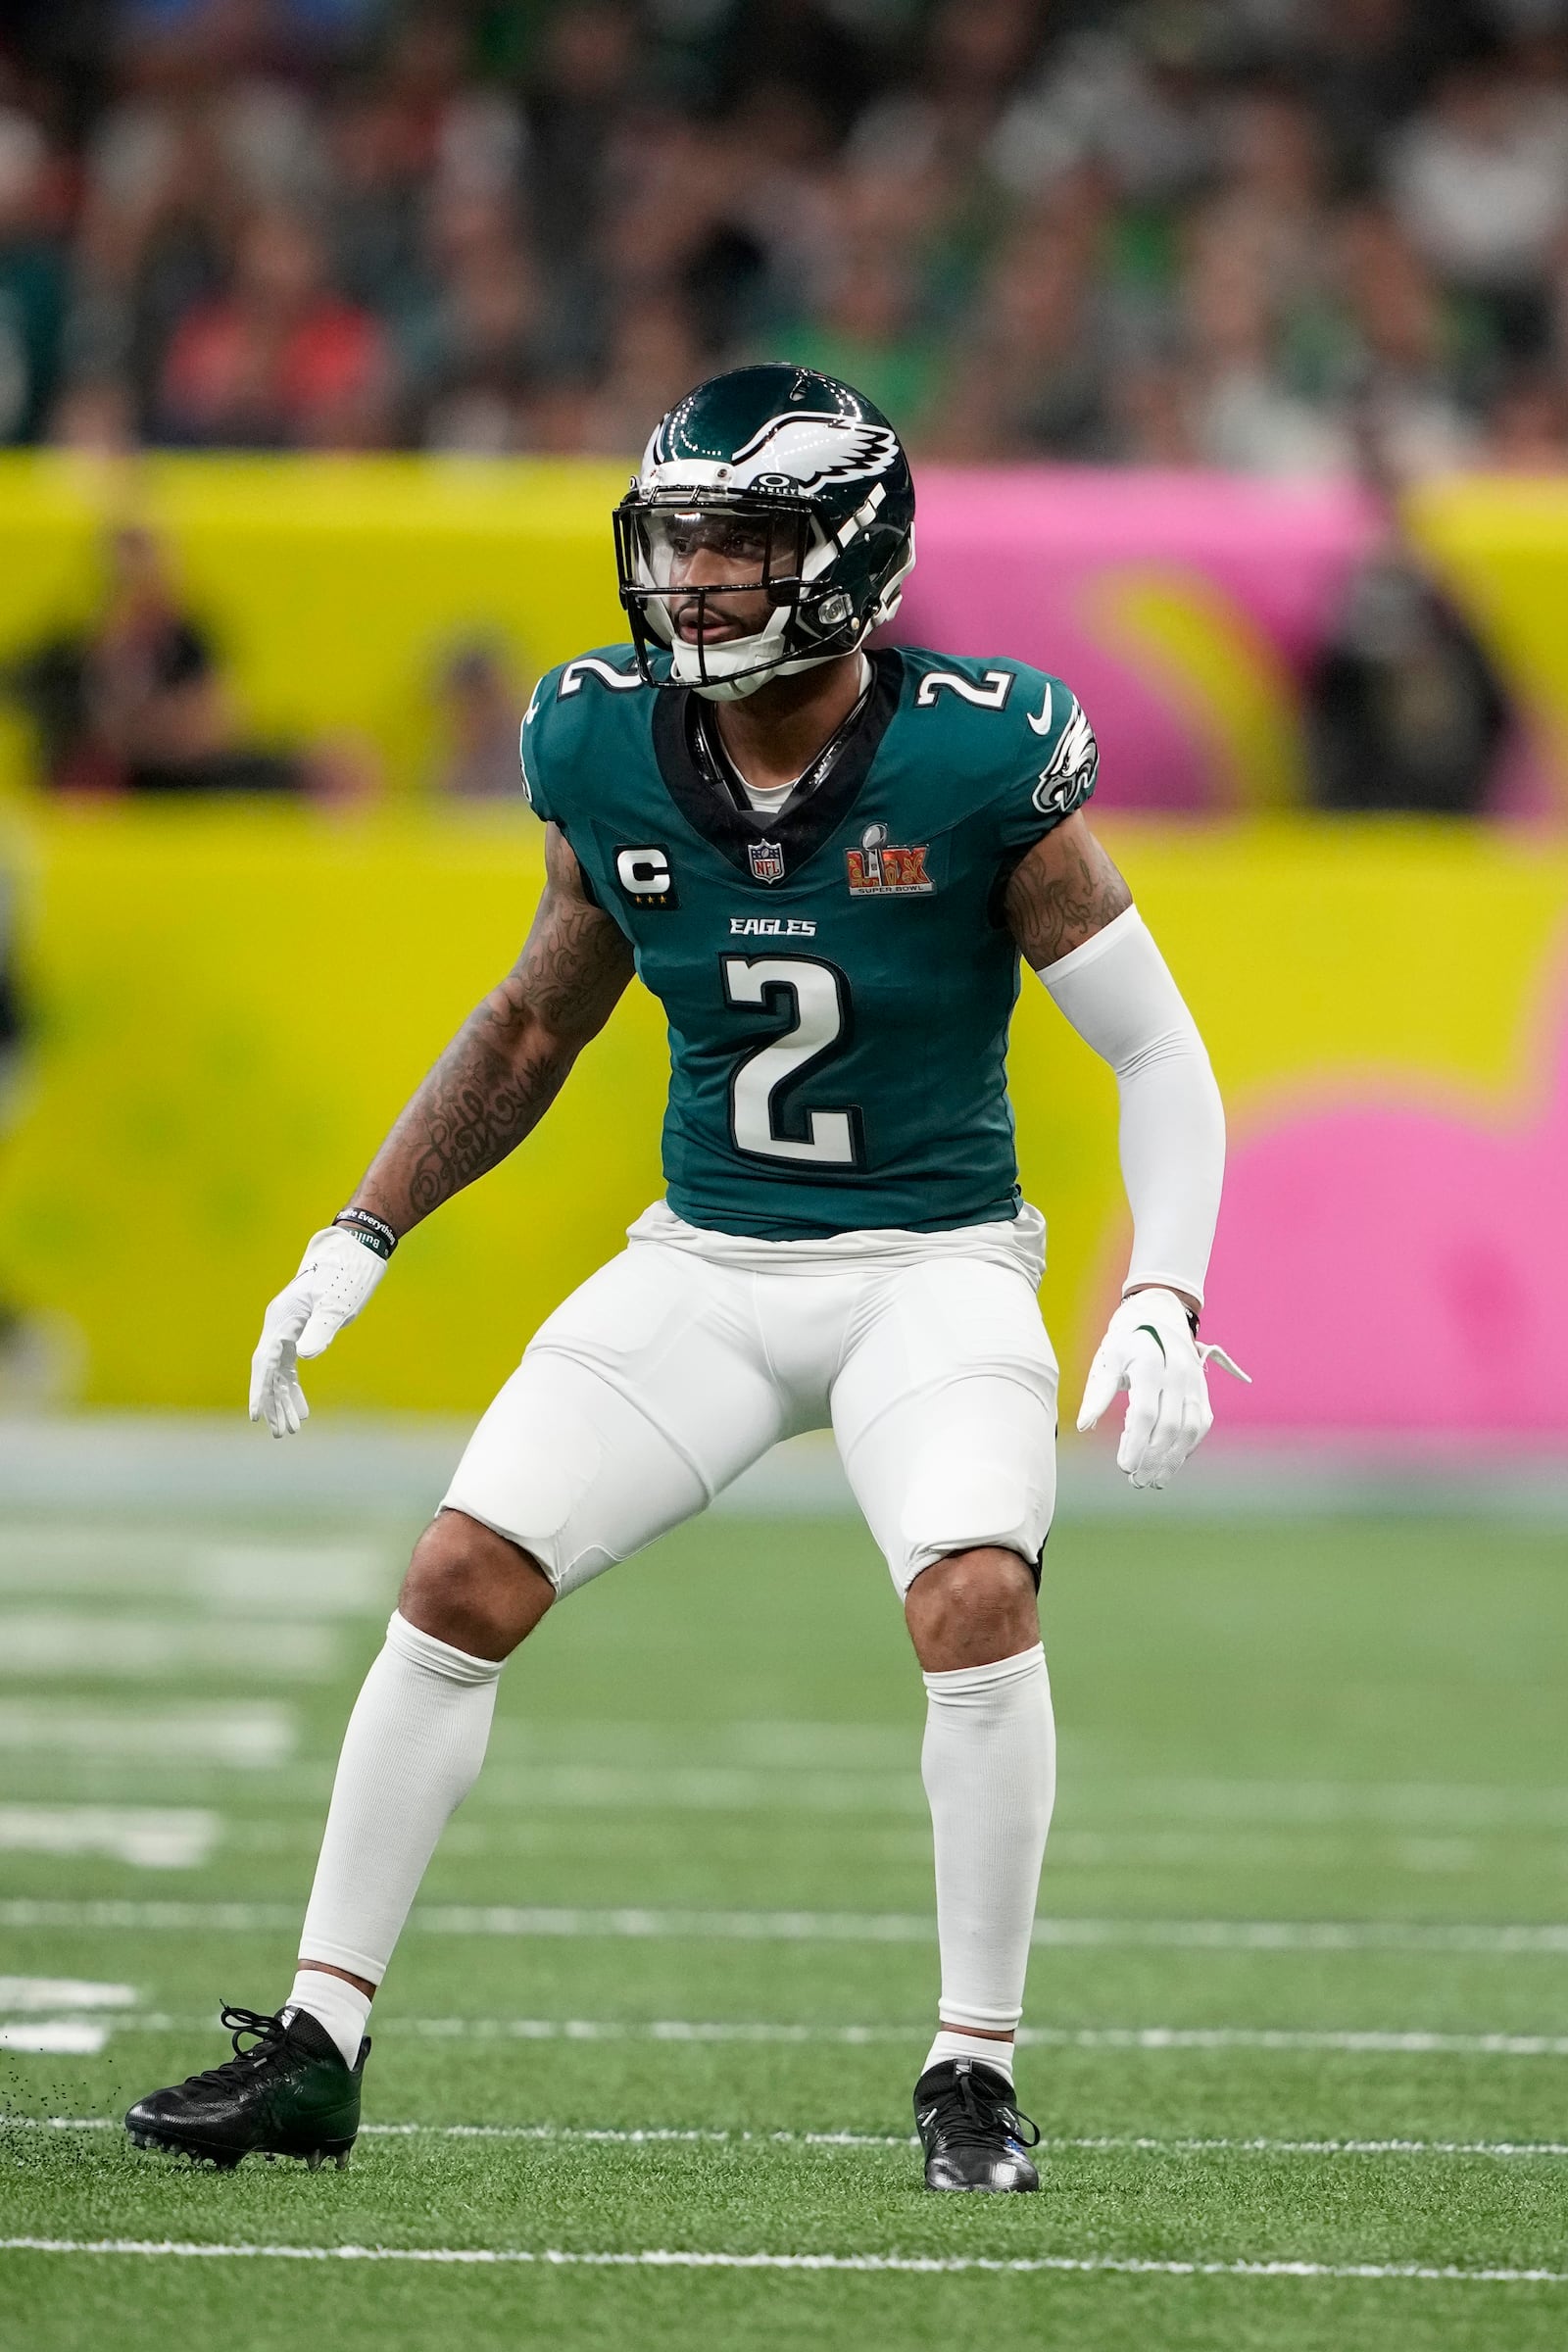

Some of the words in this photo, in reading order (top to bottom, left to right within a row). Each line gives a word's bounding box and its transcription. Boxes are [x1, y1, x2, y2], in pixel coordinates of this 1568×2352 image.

[751, 485, 796, 495] OAKLEY
[558, 657, 655, 701] 2
[916, 670, 1016, 710] 2
[617, 849, 670, 894] C
[755, 859, 780, 875] NFL
[847, 847, 931, 887] LIX
[729, 918, 817, 937] EAGLES
[721, 955, 862, 1167] 2
[358, 1211, 396, 1246] Everything
